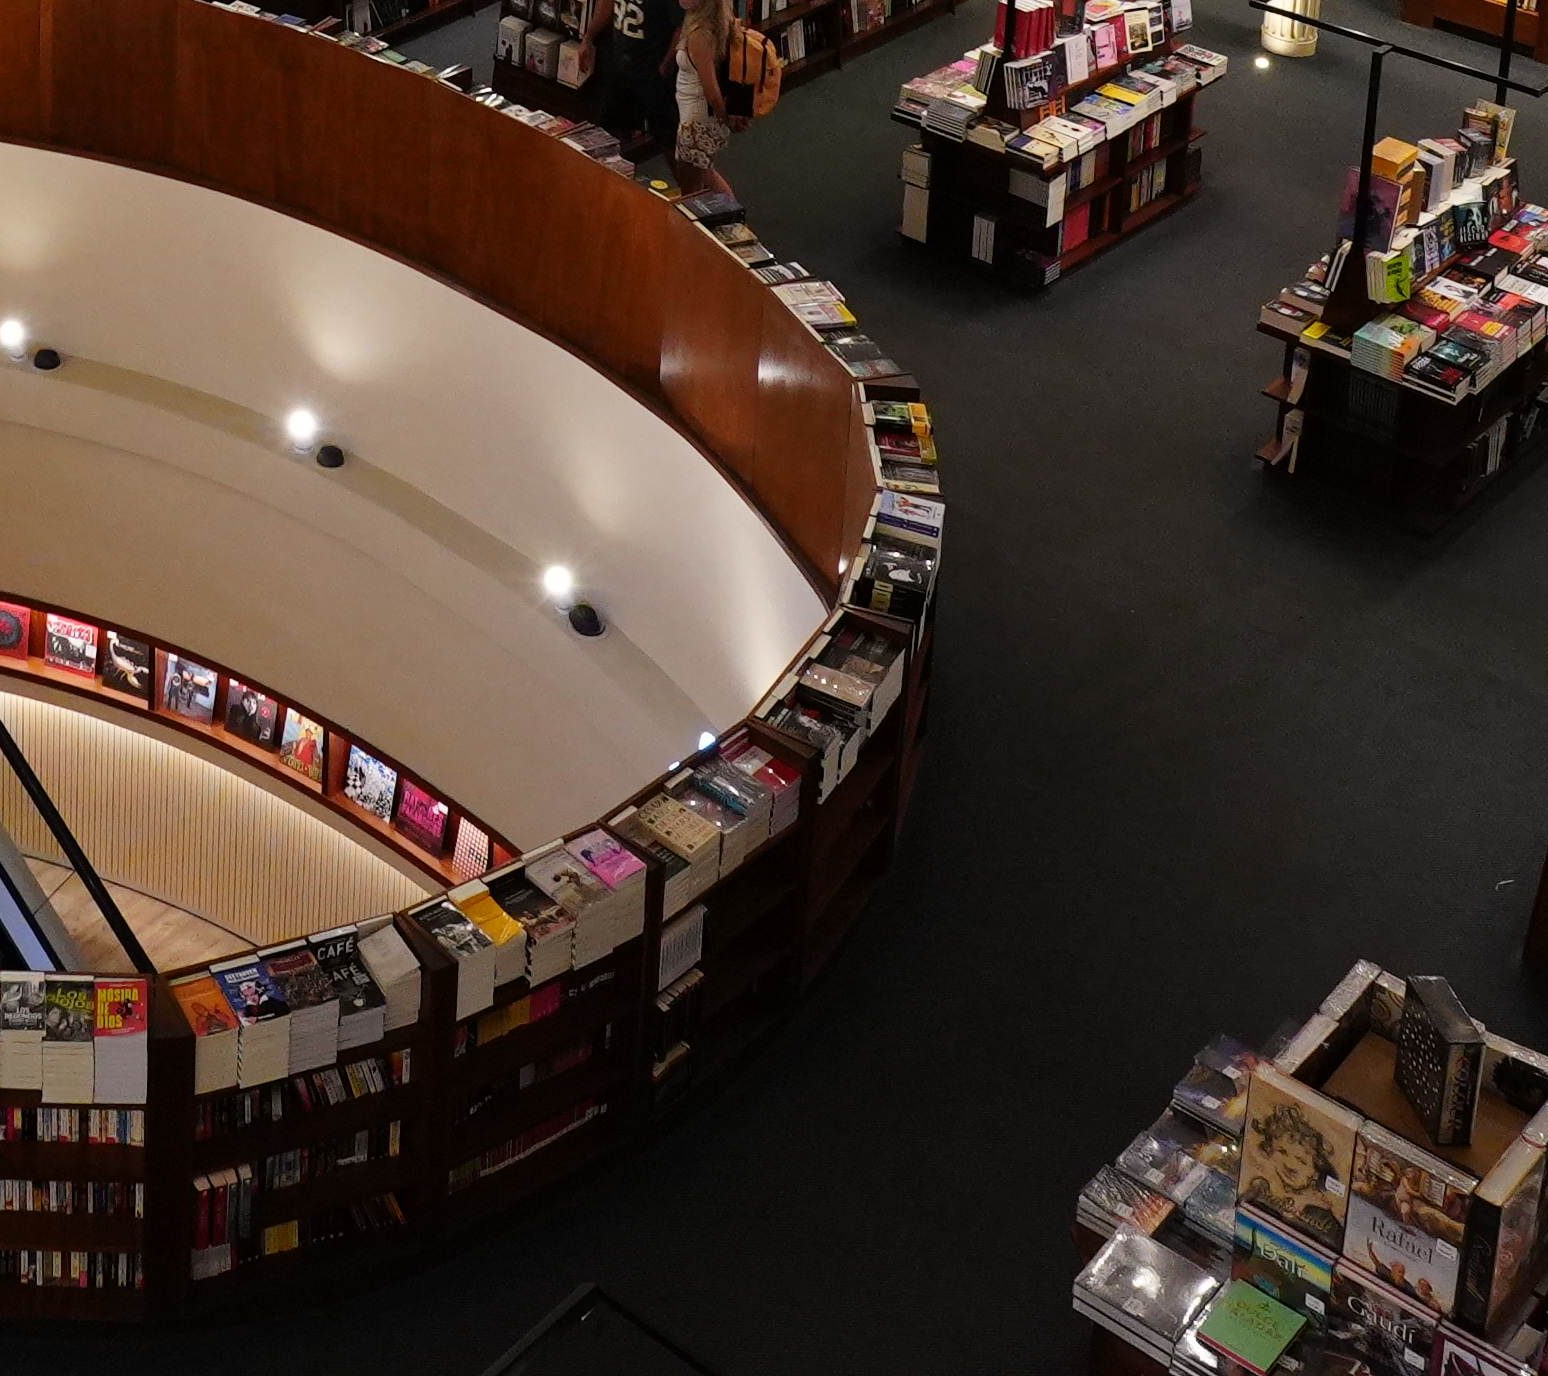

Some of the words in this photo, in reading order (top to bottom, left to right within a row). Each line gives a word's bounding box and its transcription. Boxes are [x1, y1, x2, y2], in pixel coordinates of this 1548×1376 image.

[316, 935, 355, 961] CAFÉ
[97, 1014, 123, 1029] DIOS
[1371, 1214, 1435, 1265] Rafael
[1347, 1297, 1416, 1345] Gaudí
